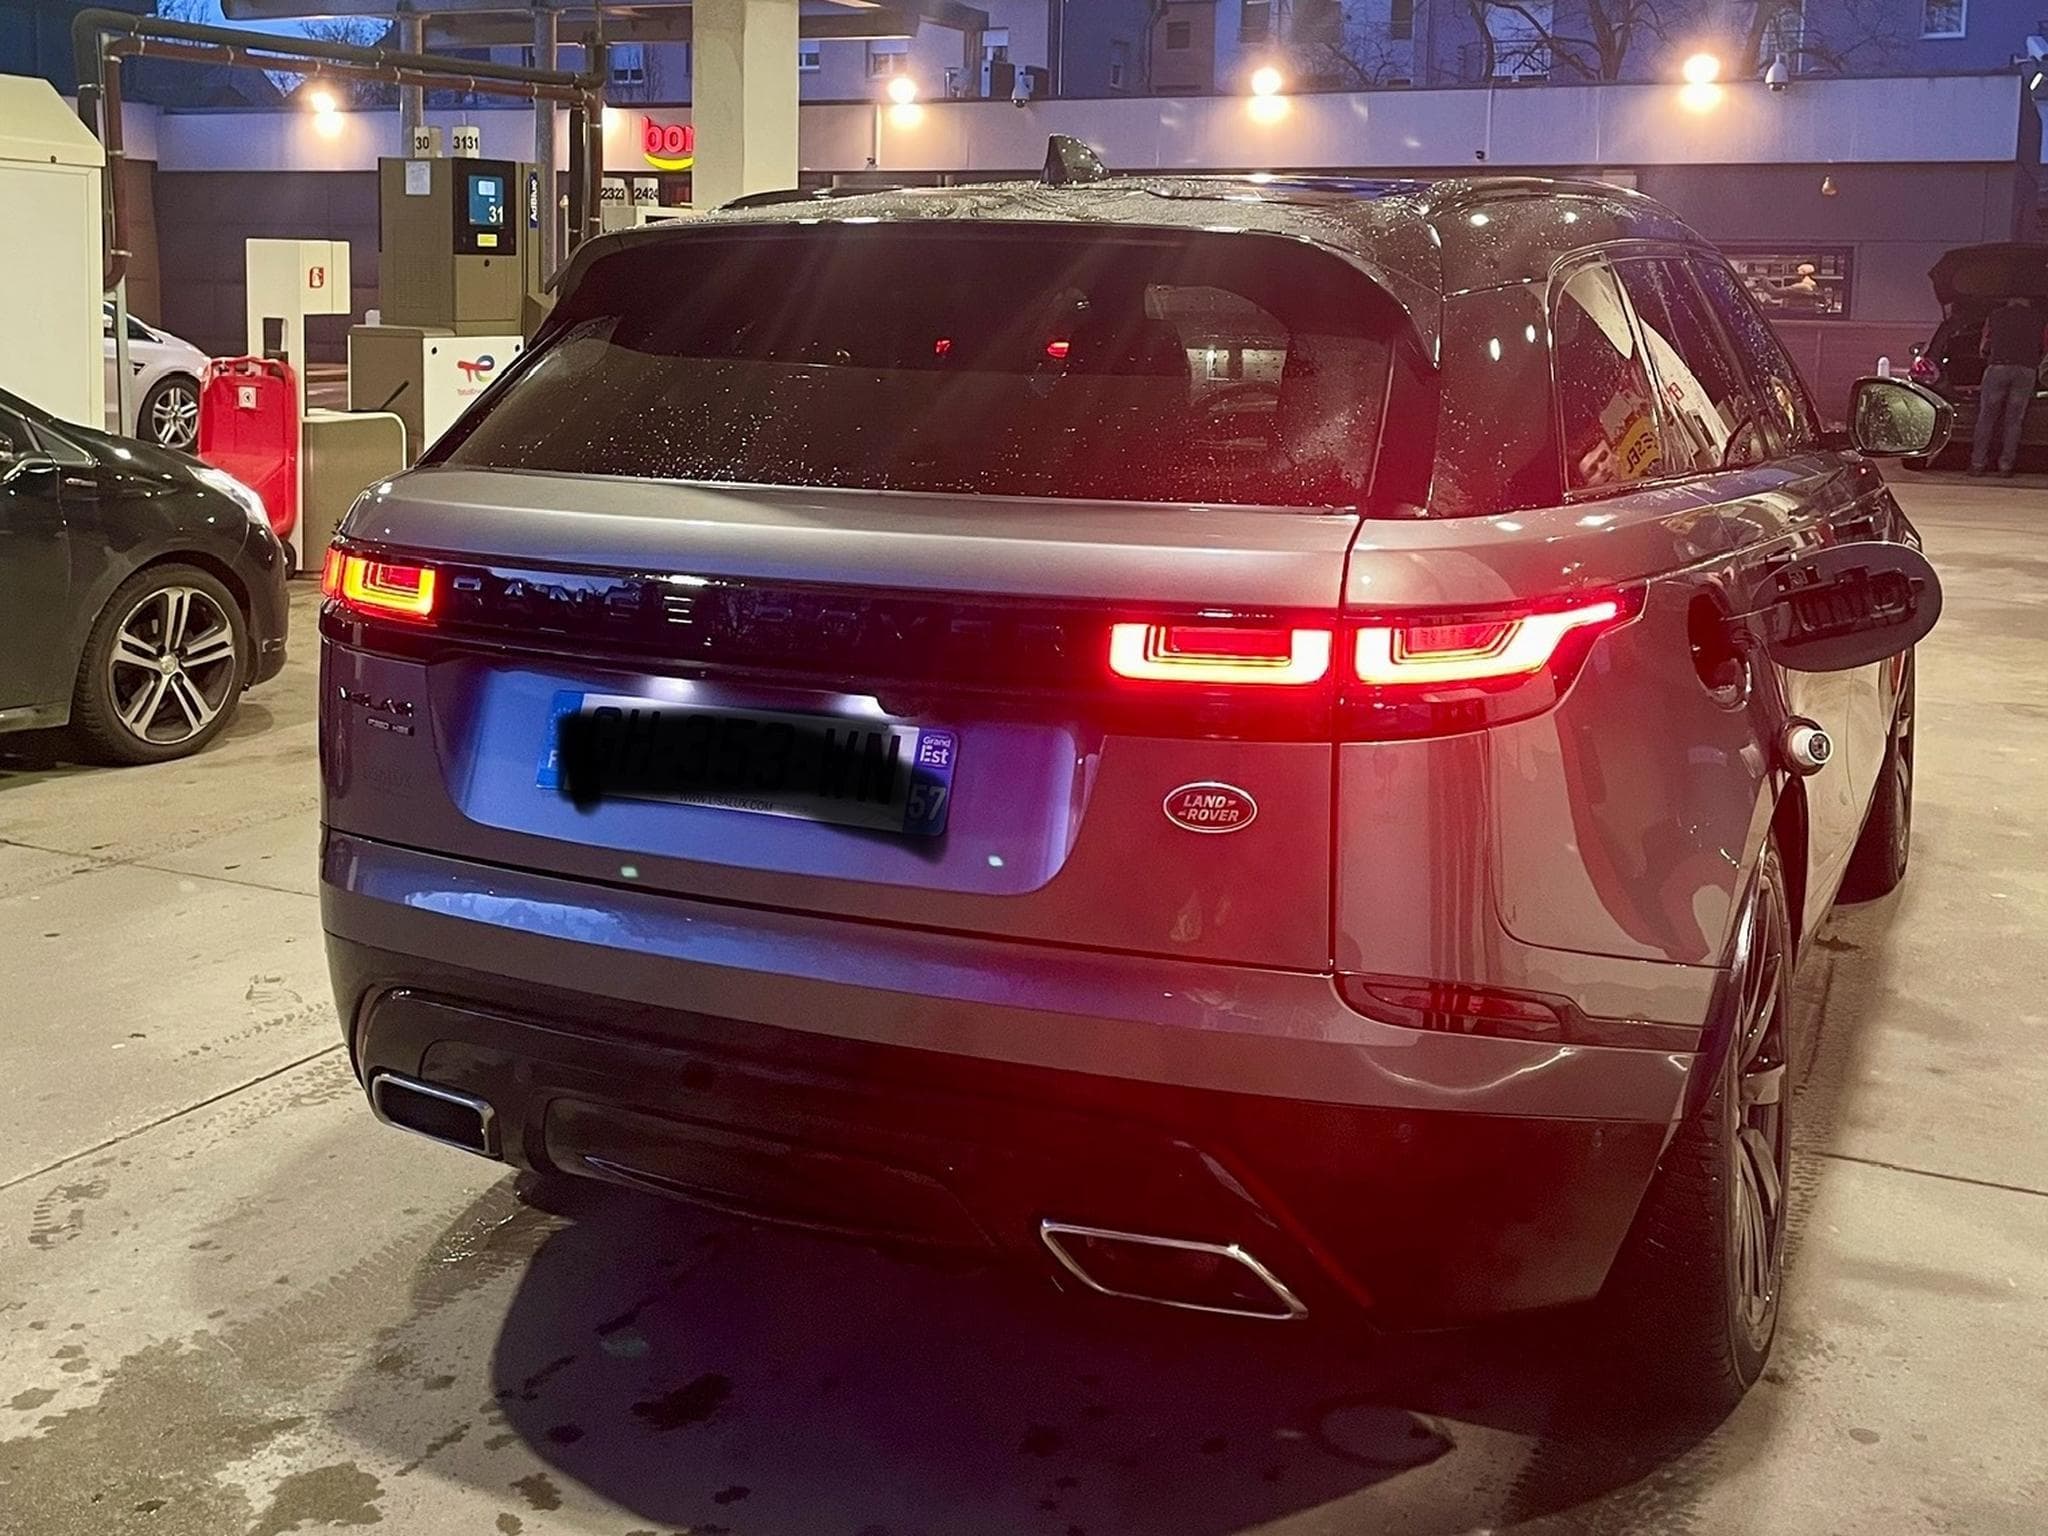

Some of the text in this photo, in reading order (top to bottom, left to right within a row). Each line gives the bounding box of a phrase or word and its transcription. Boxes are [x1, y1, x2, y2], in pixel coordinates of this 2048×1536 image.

[415, 136, 430, 150] 30
[530, 179, 538, 221] AdBlue
[488, 205, 504, 223] 31
[923, 736, 951, 747] Grand
[920, 745, 949, 764] Est
[1183, 795, 1227, 809] LAND
[1187, 809, 1239, 821] ROVER
